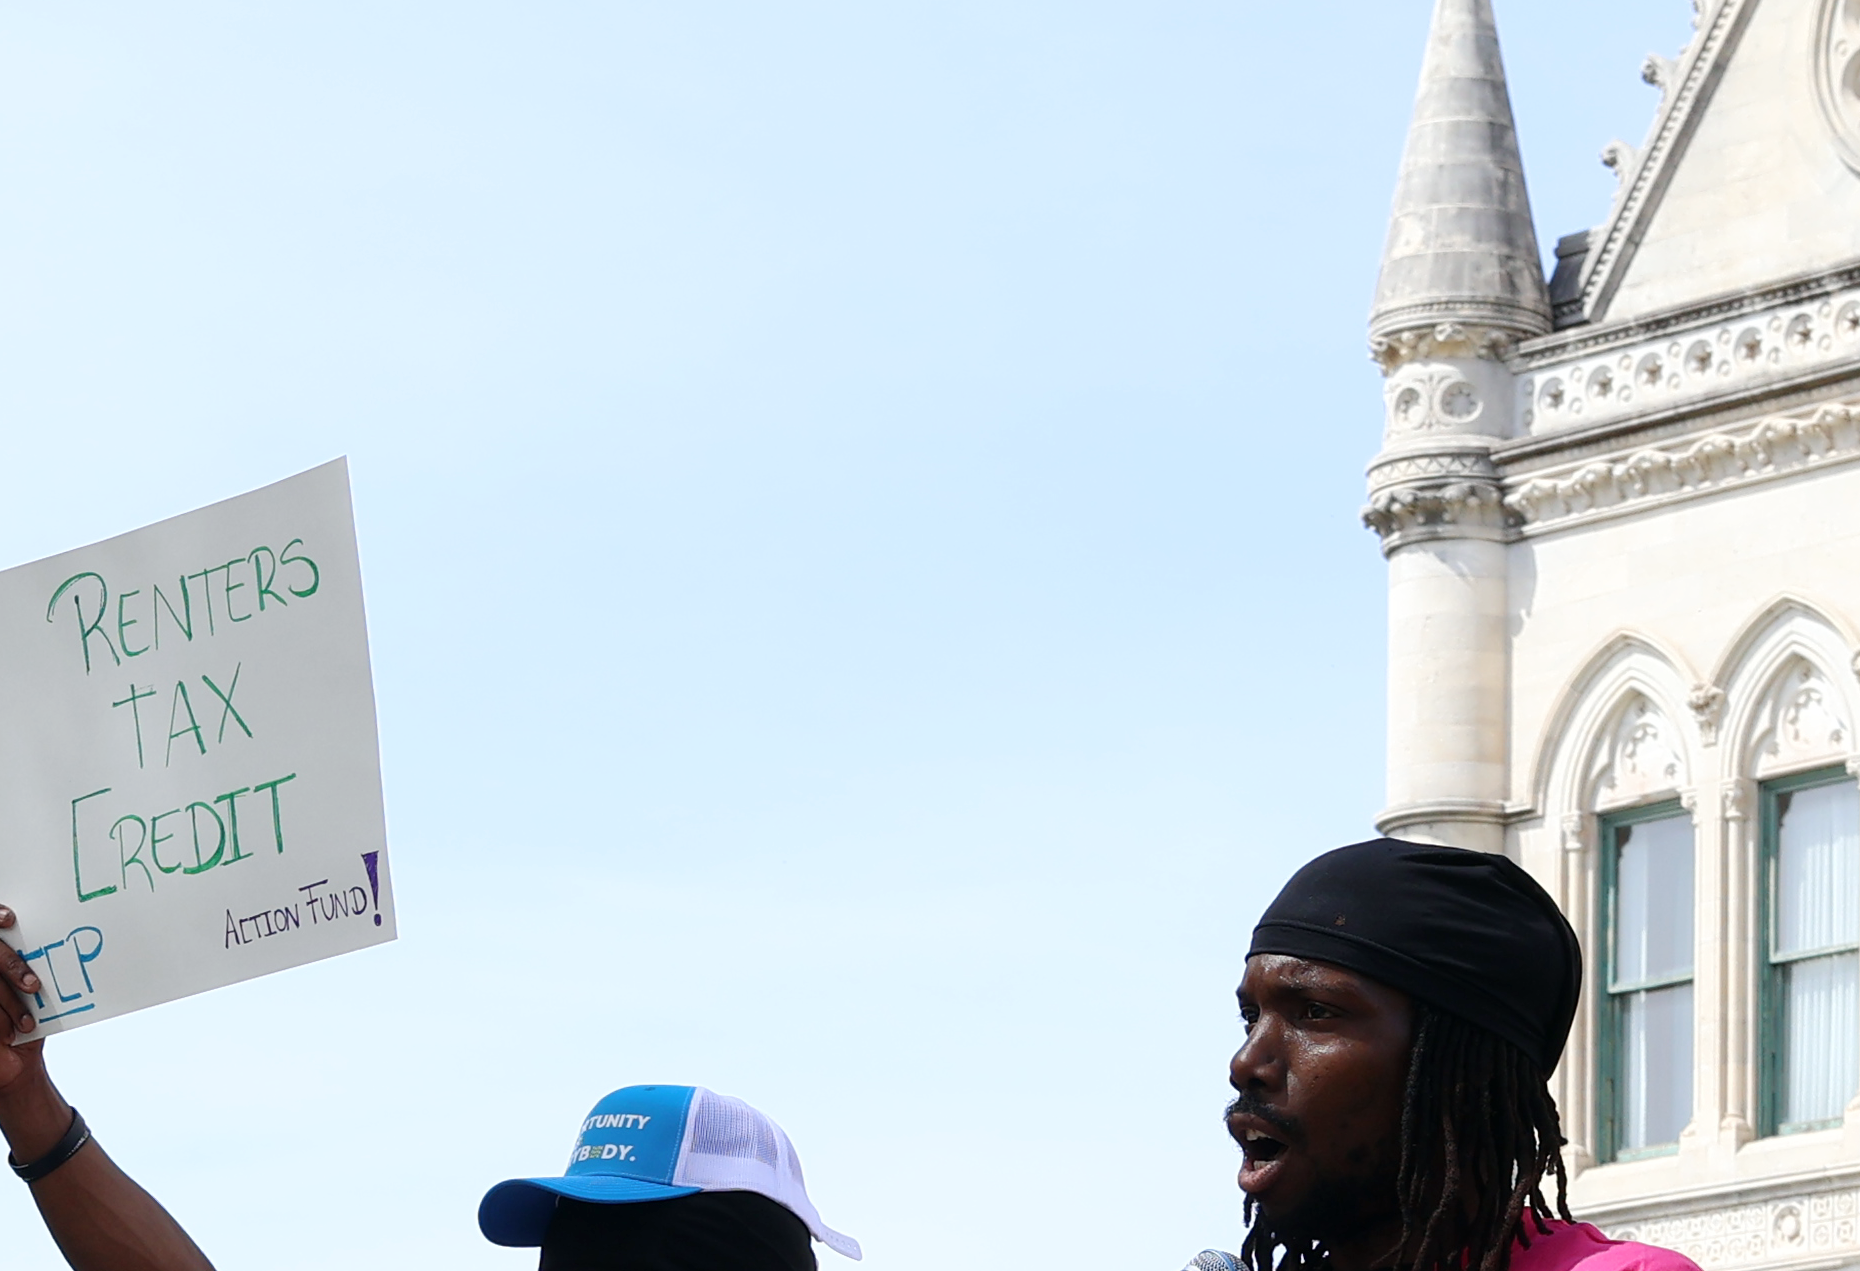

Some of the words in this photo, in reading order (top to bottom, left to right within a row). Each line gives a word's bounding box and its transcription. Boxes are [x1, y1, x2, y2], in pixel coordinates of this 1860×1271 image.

[46, 538, 320, 675] RENTERS
[111, 662, 253, 769] TAX
[71, 772, 297, 903] CREDIT
[225, 903, 300, 949] ACTION
